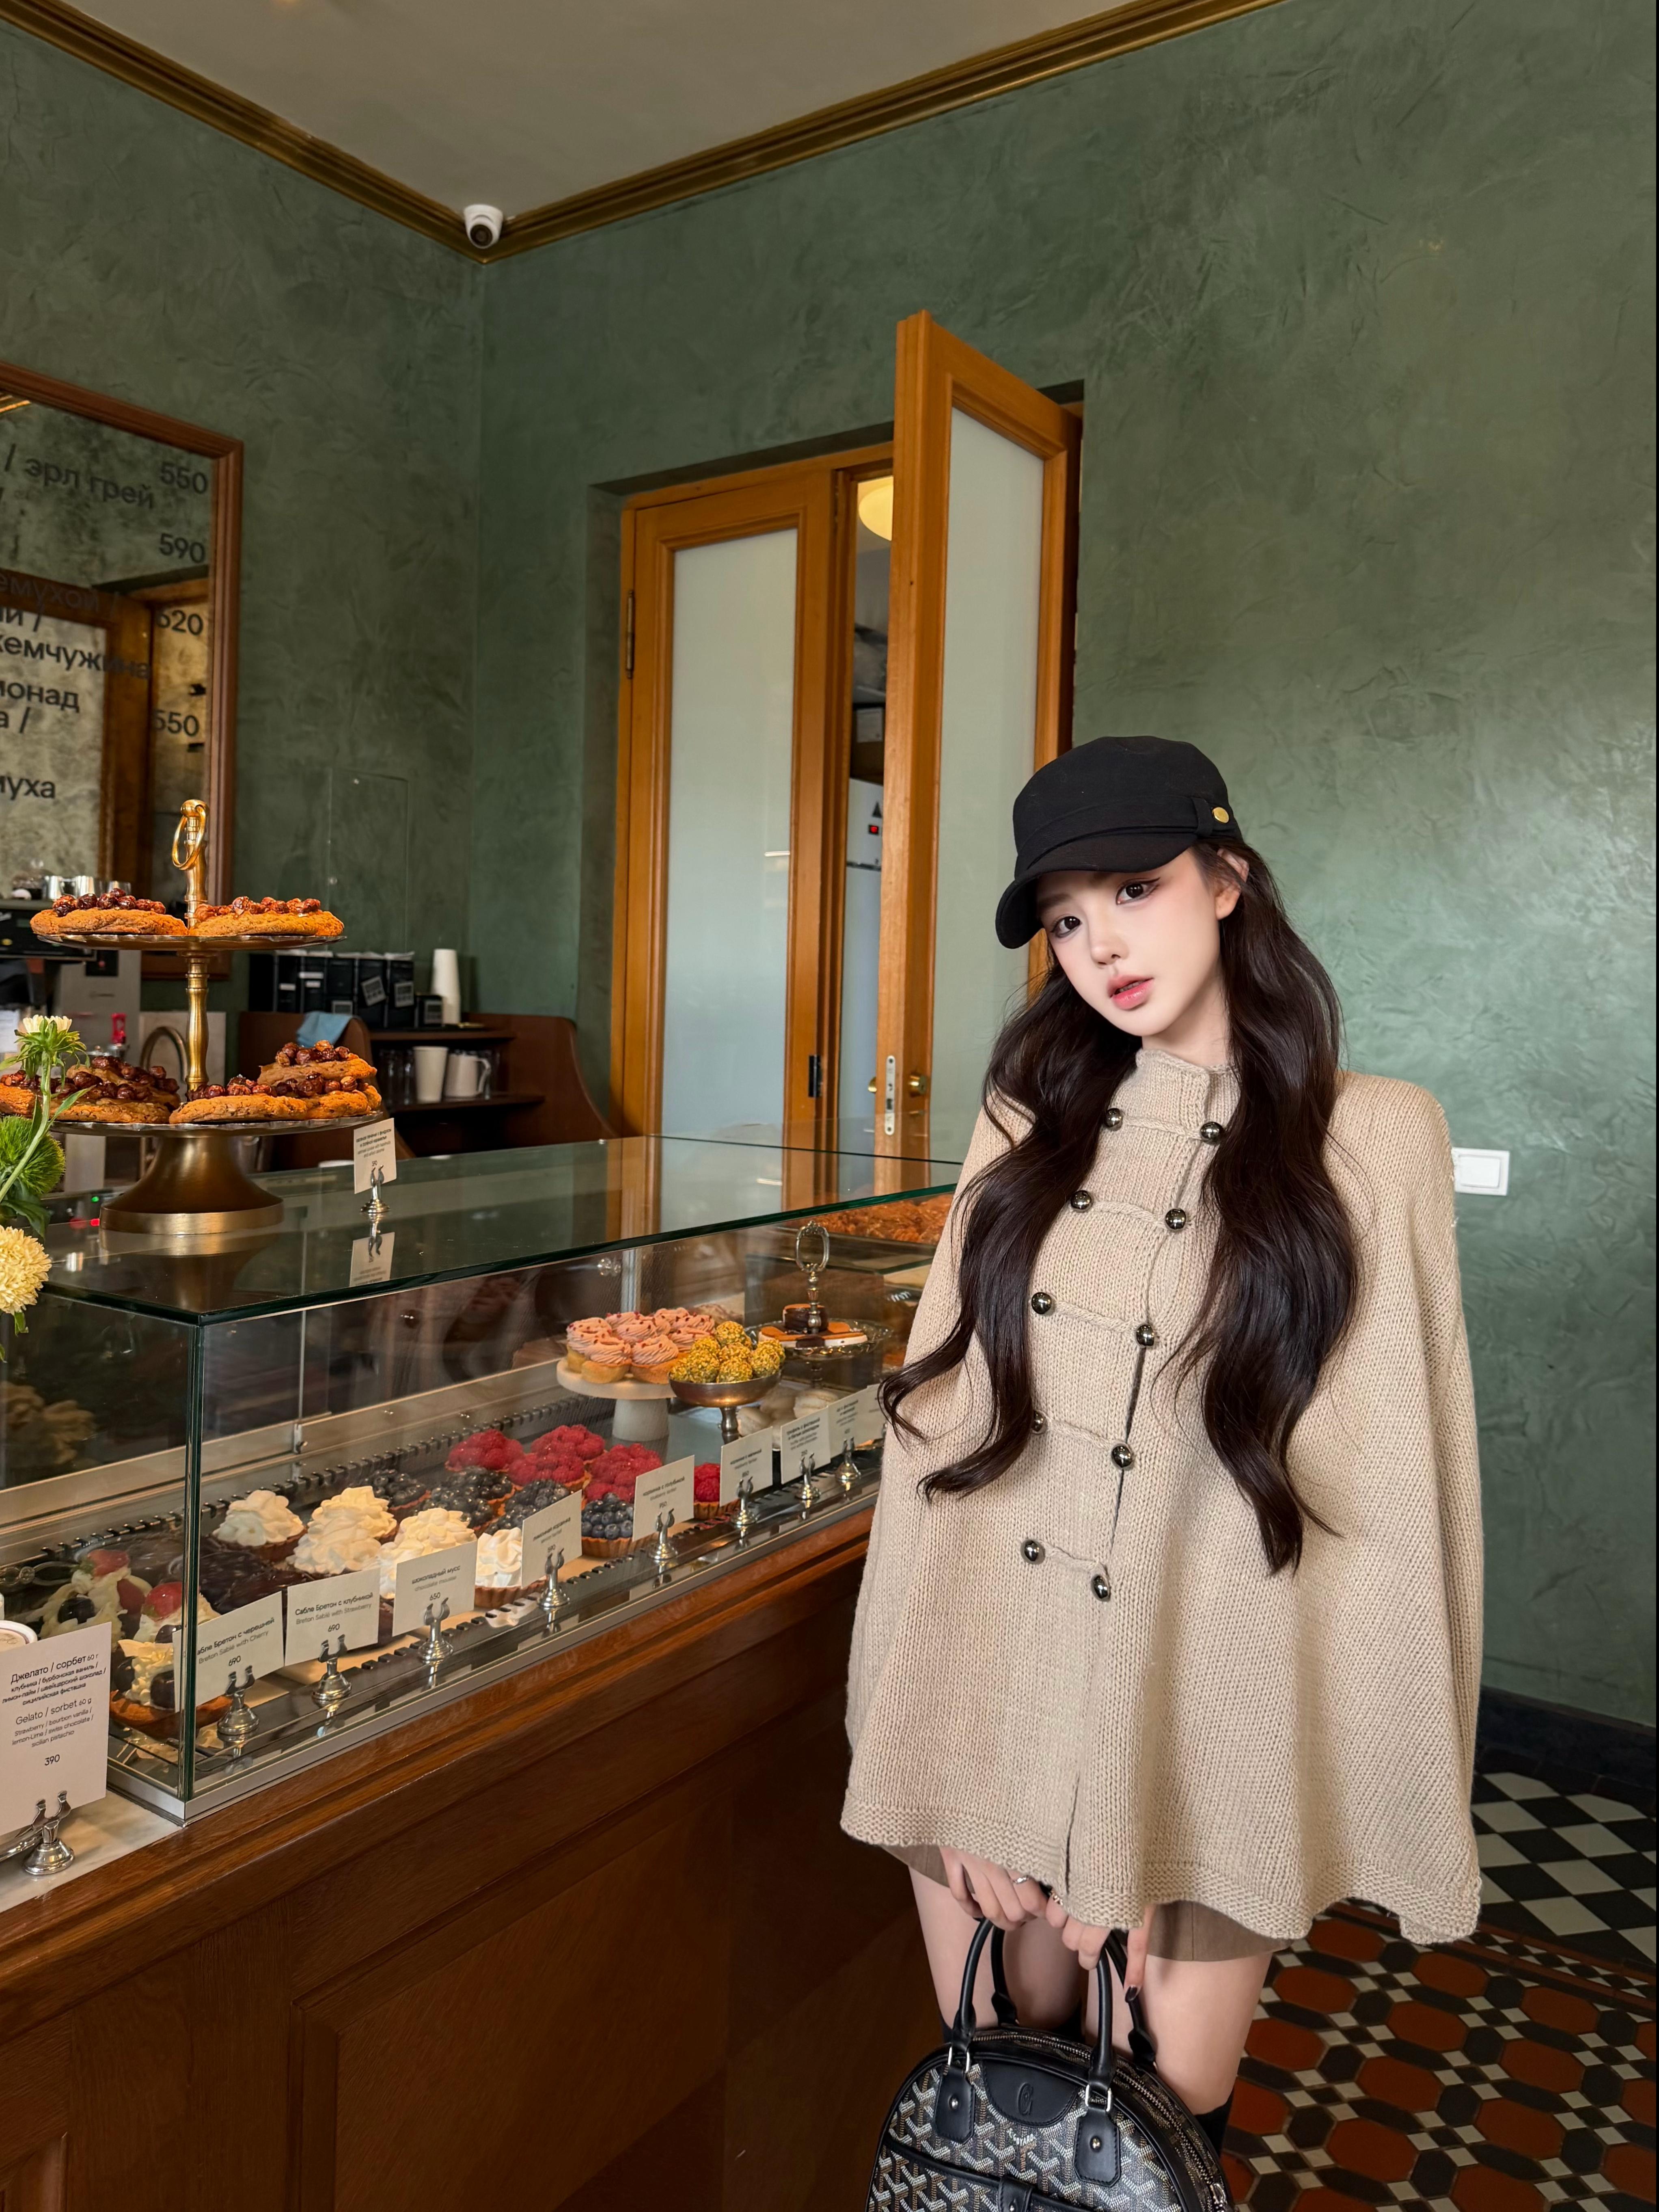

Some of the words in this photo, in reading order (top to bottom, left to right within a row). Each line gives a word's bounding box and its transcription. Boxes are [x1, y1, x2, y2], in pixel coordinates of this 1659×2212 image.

[24, 458, 80, 489] эрл
[90, 476, 154, 510] грей
[159, 461, 209, 495] 550
[158, 533, 205, 563] 590
[429, 1592, 441, 1601] 650
[197, 1644, 213, 1656] абле
[11, 1667, 49, 1685] Джелато
[56, 1655, 87, 1669] сорбет
[15, 1711, 43, 1725] Gelato
[51, 1700, 77, 1715] sorbet
[15, 1723, 45, 1737] Strawberry
[48, 1715, 72, 1726] bourbon
[44, 1754, 60, 1766] 390
